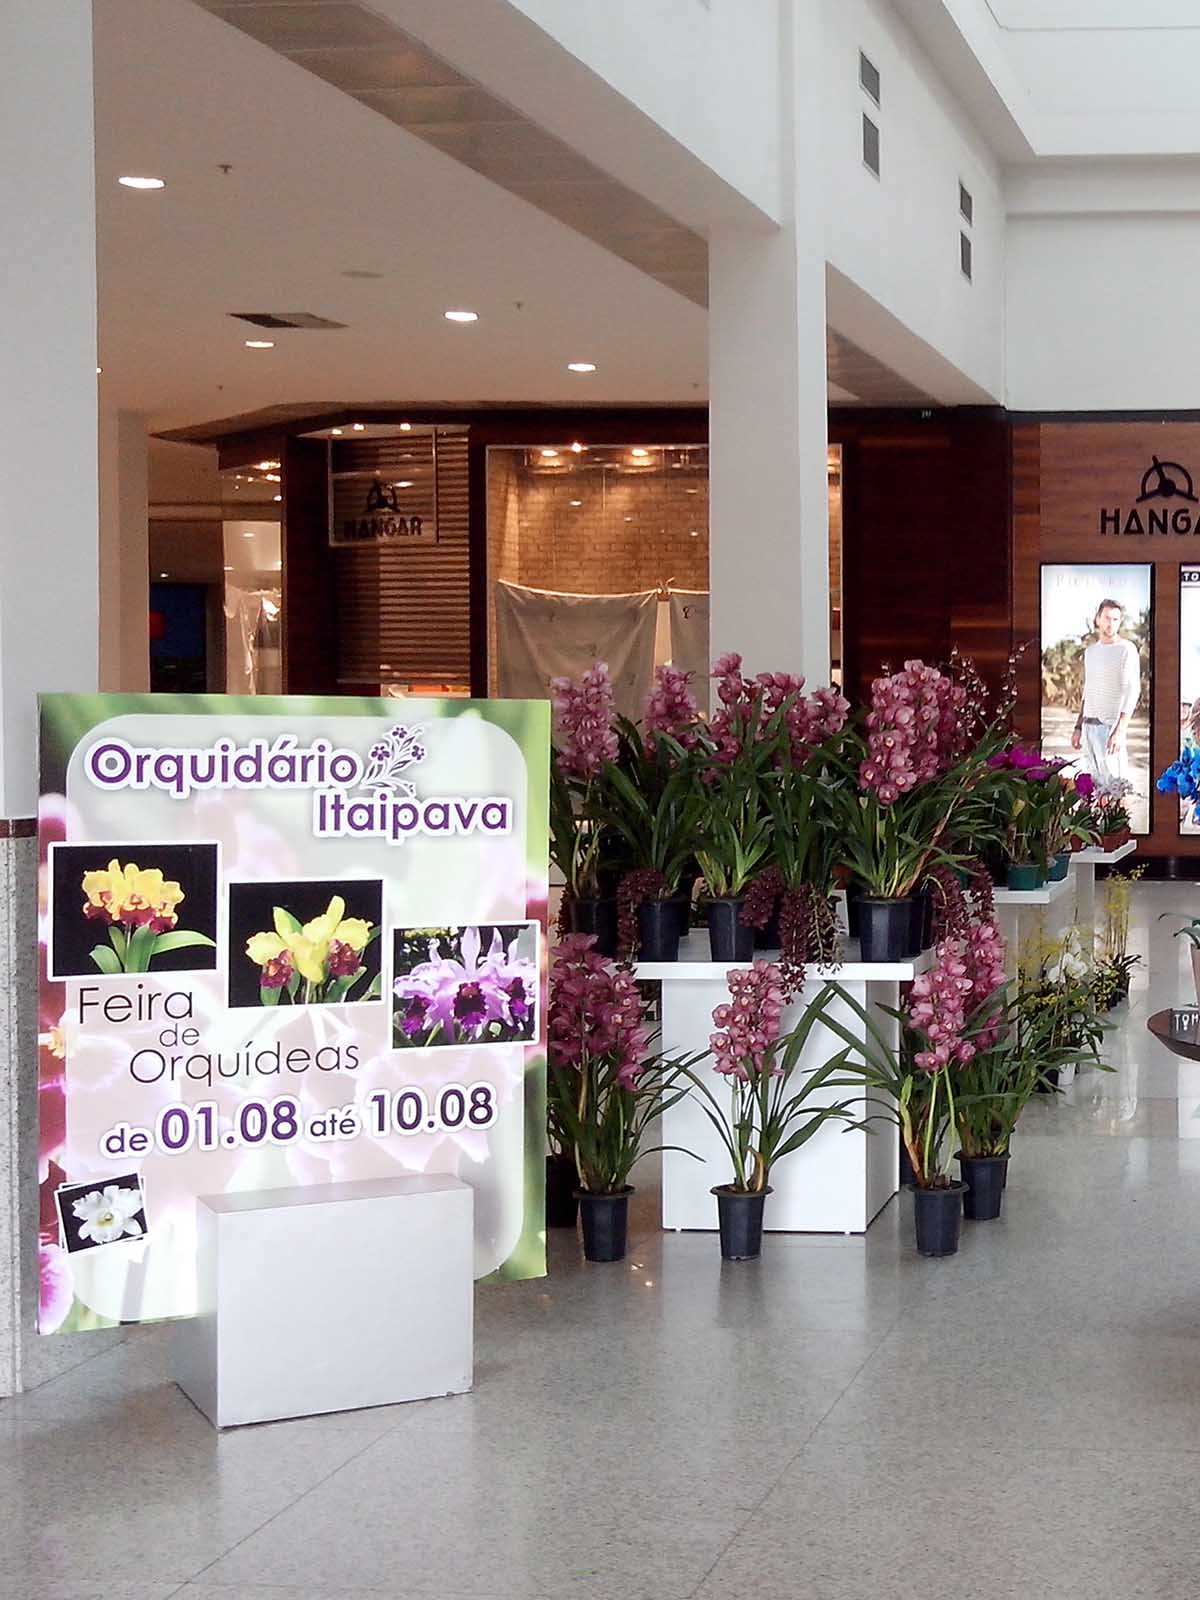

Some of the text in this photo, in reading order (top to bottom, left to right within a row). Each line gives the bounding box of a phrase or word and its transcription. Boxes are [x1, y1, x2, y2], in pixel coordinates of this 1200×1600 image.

[343, 516, 423, 537] HANGAR
[91, 740, 358, 793] Orquidário
[319, 794, 507, 839] Itaipava
[79, 984, 194, 1024] Feira
[159, 1021, 200, 1047] de
[130, 1041, 359, 1087] Orquídeas
[106, 1086, 494, 1153] de 01.08 até 10.08
